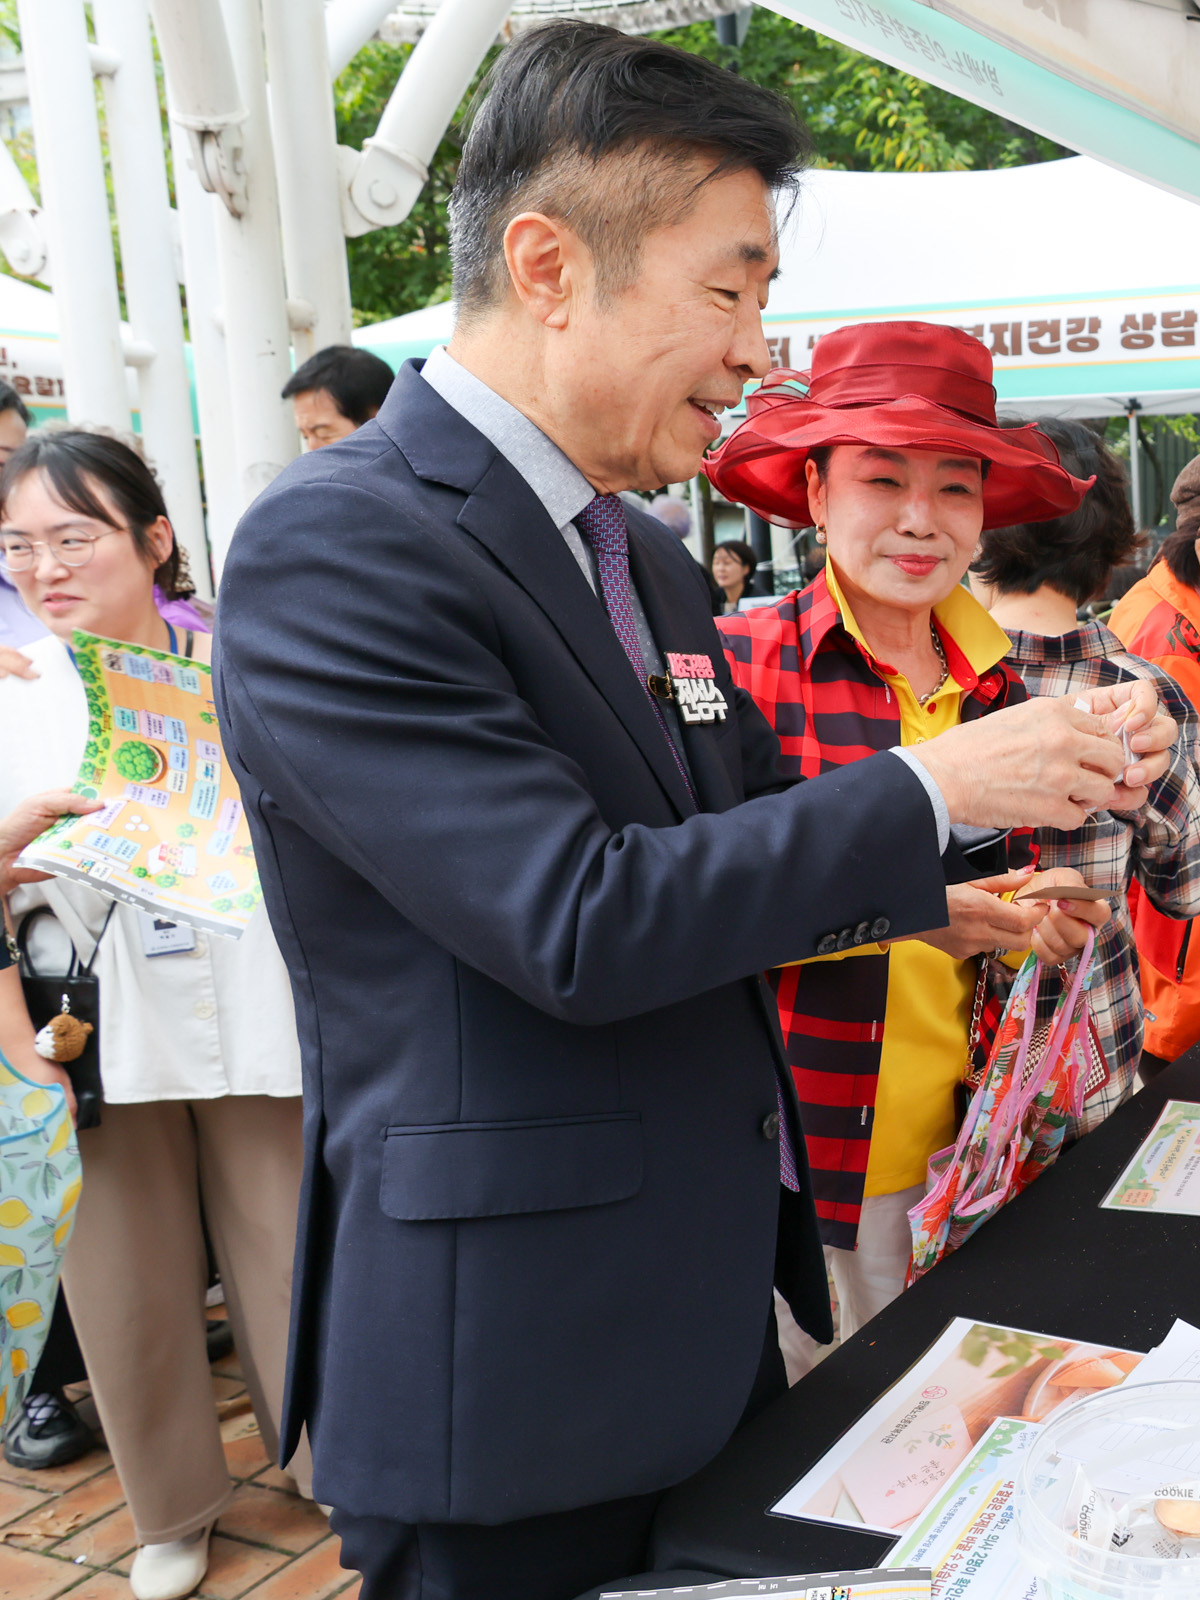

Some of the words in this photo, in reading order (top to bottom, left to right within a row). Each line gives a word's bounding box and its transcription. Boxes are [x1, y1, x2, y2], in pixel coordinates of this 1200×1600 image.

[880, 1400, 931, 1445] 방배노인종합복지관
[986, 1490, 1013, 1512] 결정은
[1154, 1488, 1194, 1498] COOKIE
[968, 1513, 996, 1535] 언제든
[955, 1536, 979, 1552] 바꿀
[982, 1534, 1001, 1552] 의사
[949, 1551, 965, 1562] 수
[966, 1552, 988, 1577] 2명이
[943, 1577, 973, 1600] 확인
